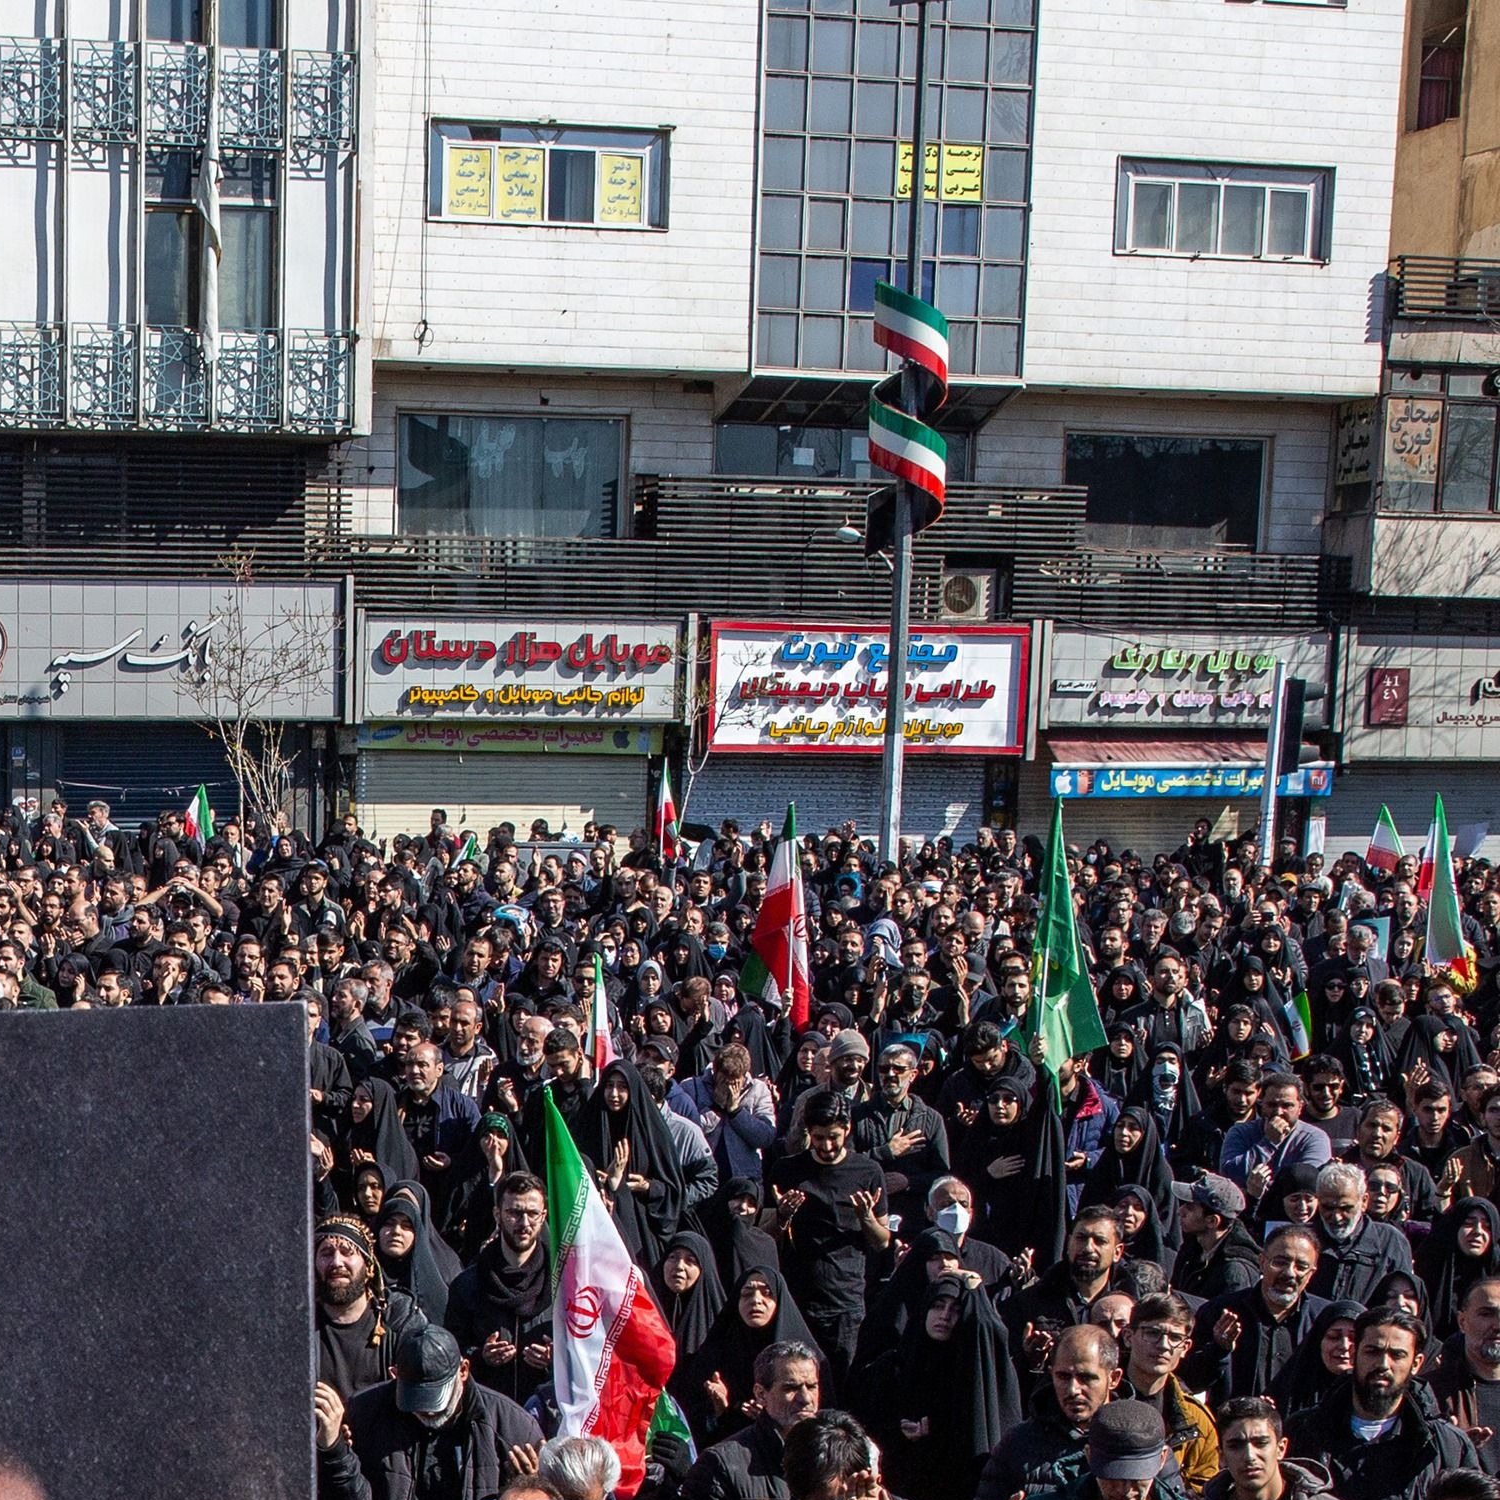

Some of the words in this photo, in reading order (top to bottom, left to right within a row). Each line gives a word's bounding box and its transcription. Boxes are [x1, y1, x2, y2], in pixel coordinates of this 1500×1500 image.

[947, 146, 980, 161] ترجمه
[503, 170, 537, 183] رسمی
[946, 168, 980, 177] رسمی
[945, 184, 980, 195] عربی
[1390, 399, 1439, 432] صحافی
[1393, 423, 1432, 454] فوری
[383, 629, 497, 666] دستان
[505, 632, 562, 668] هزار
[568, 634, 671, 671] موبایل
[782, 633, 858, 669] نبوت
[867, 635, 958, 673] مجتع
[1207, 650, 1277, 682] موبایل
[740, 672, 840, 705] دیجیتال
[915, 680, 996, 703] طراحی
[1383, 674, 1400, 686] 41
[408, 684, 479, 707] کامپیوتر
[485, 690, 494, 703] و
[499, 684, 553, 704] موبایل
[557, 685, 602, 705] جانبی
[607, 687, 644, 707] لوازم
[406, 723, 464, 745] موبایل
[467, 724, 539, 746] تخصصی
[542, 724, 604, 748] تعمیرات
[769, 716, 829, 743] جانبی
[830, 715, 887, 743] لوازم
[902, 719, 963, 742] موبایل
[1101, 769, 1155, 793] موبایل
[1157, 768, 1222, 793] تخصصی
[1225, 769, 1280, 793] میرات
